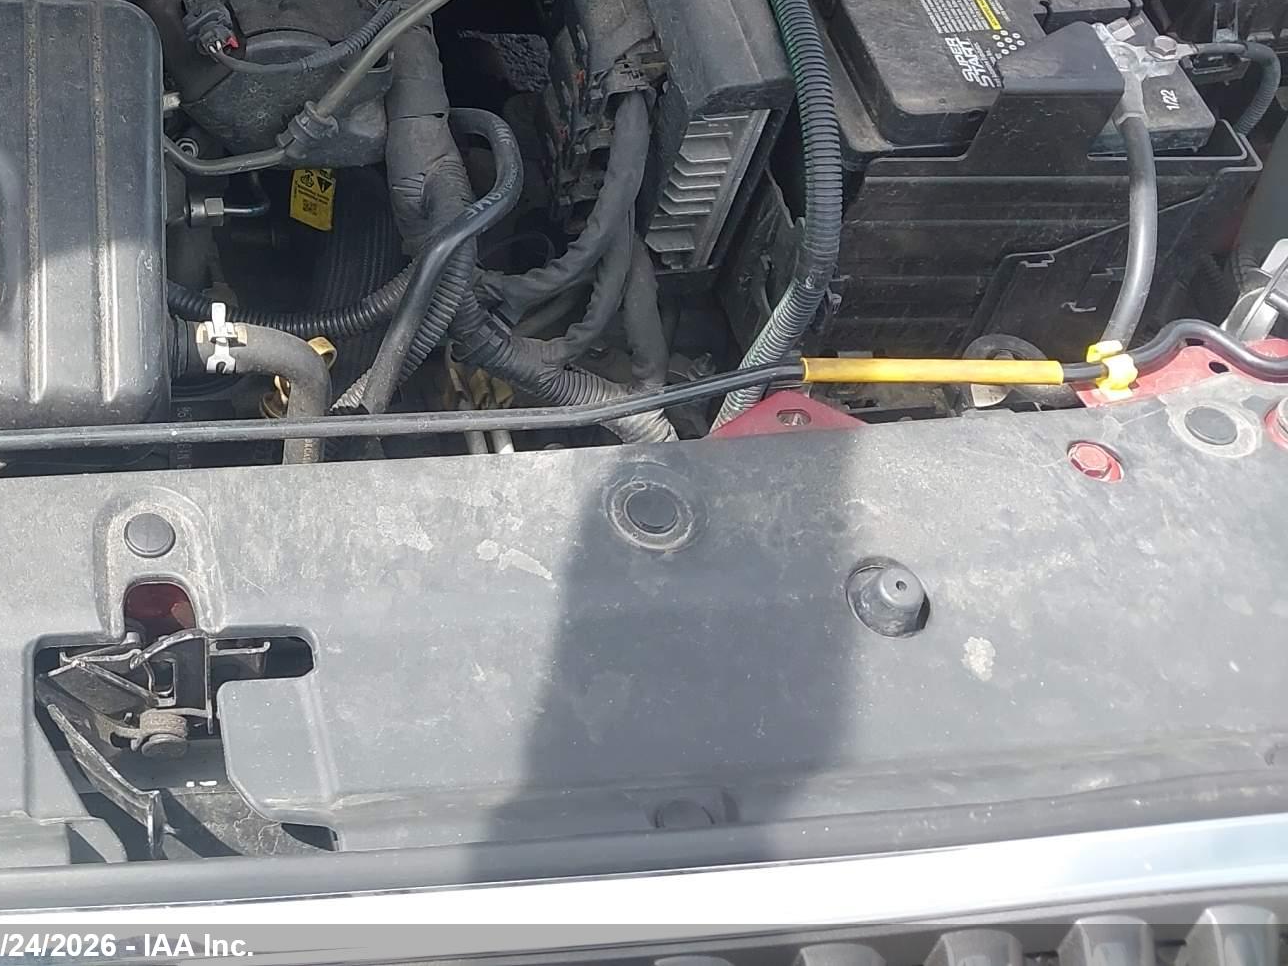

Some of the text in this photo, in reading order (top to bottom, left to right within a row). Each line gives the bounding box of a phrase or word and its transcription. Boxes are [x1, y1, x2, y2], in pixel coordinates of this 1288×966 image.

[945, 37, 979, 82] SUPER
[955, 37, 995, 88] START
[1160, 89, 1180, 110] 1/22
